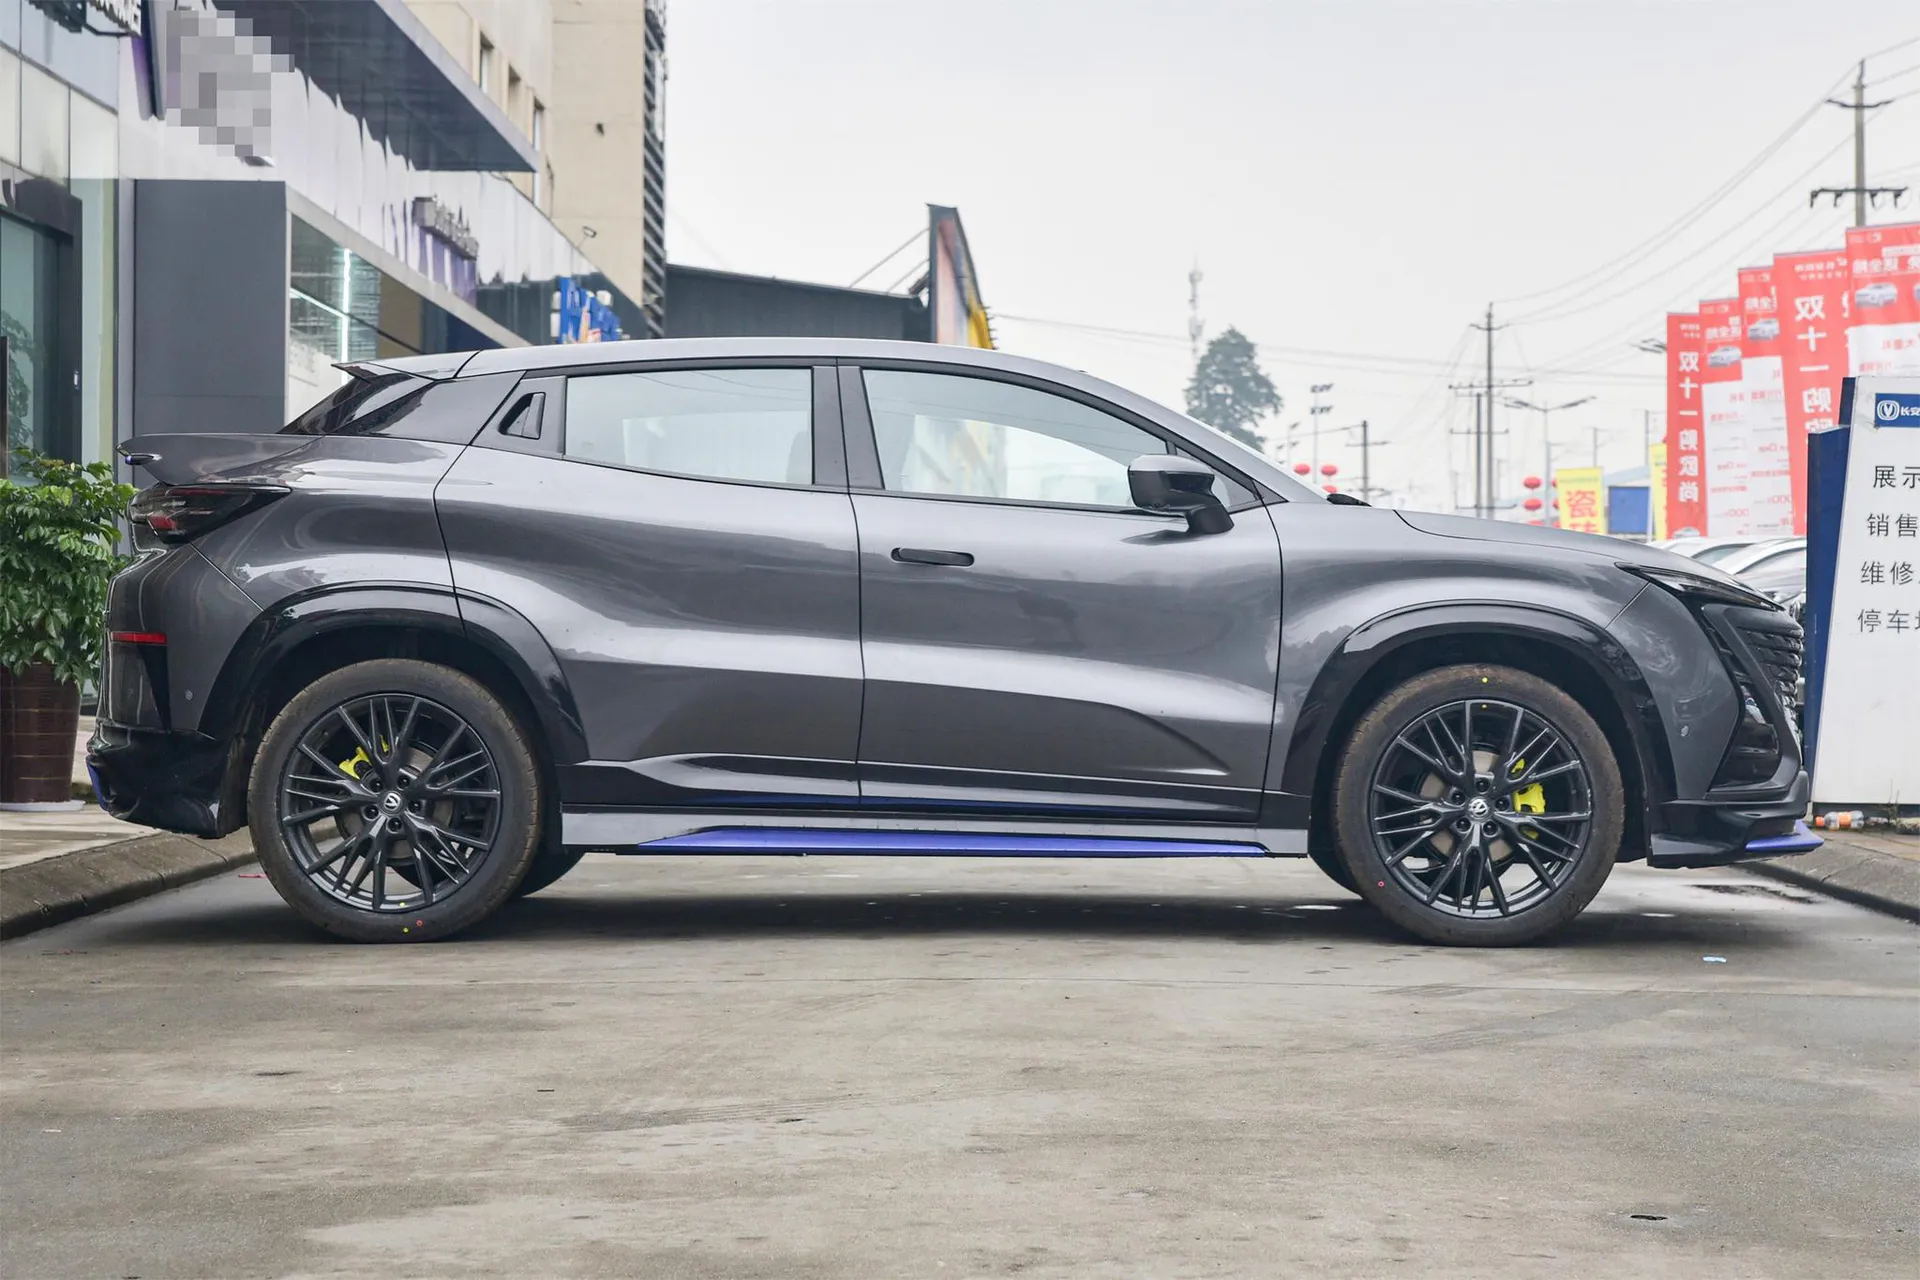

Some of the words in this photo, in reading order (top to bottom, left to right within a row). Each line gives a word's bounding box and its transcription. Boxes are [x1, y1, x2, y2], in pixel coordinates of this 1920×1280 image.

[1873, 465, 1920, 489] 展示
[1867, 513, 1918, 537] 销售
[1861, 561, 1920, 585] 维修
